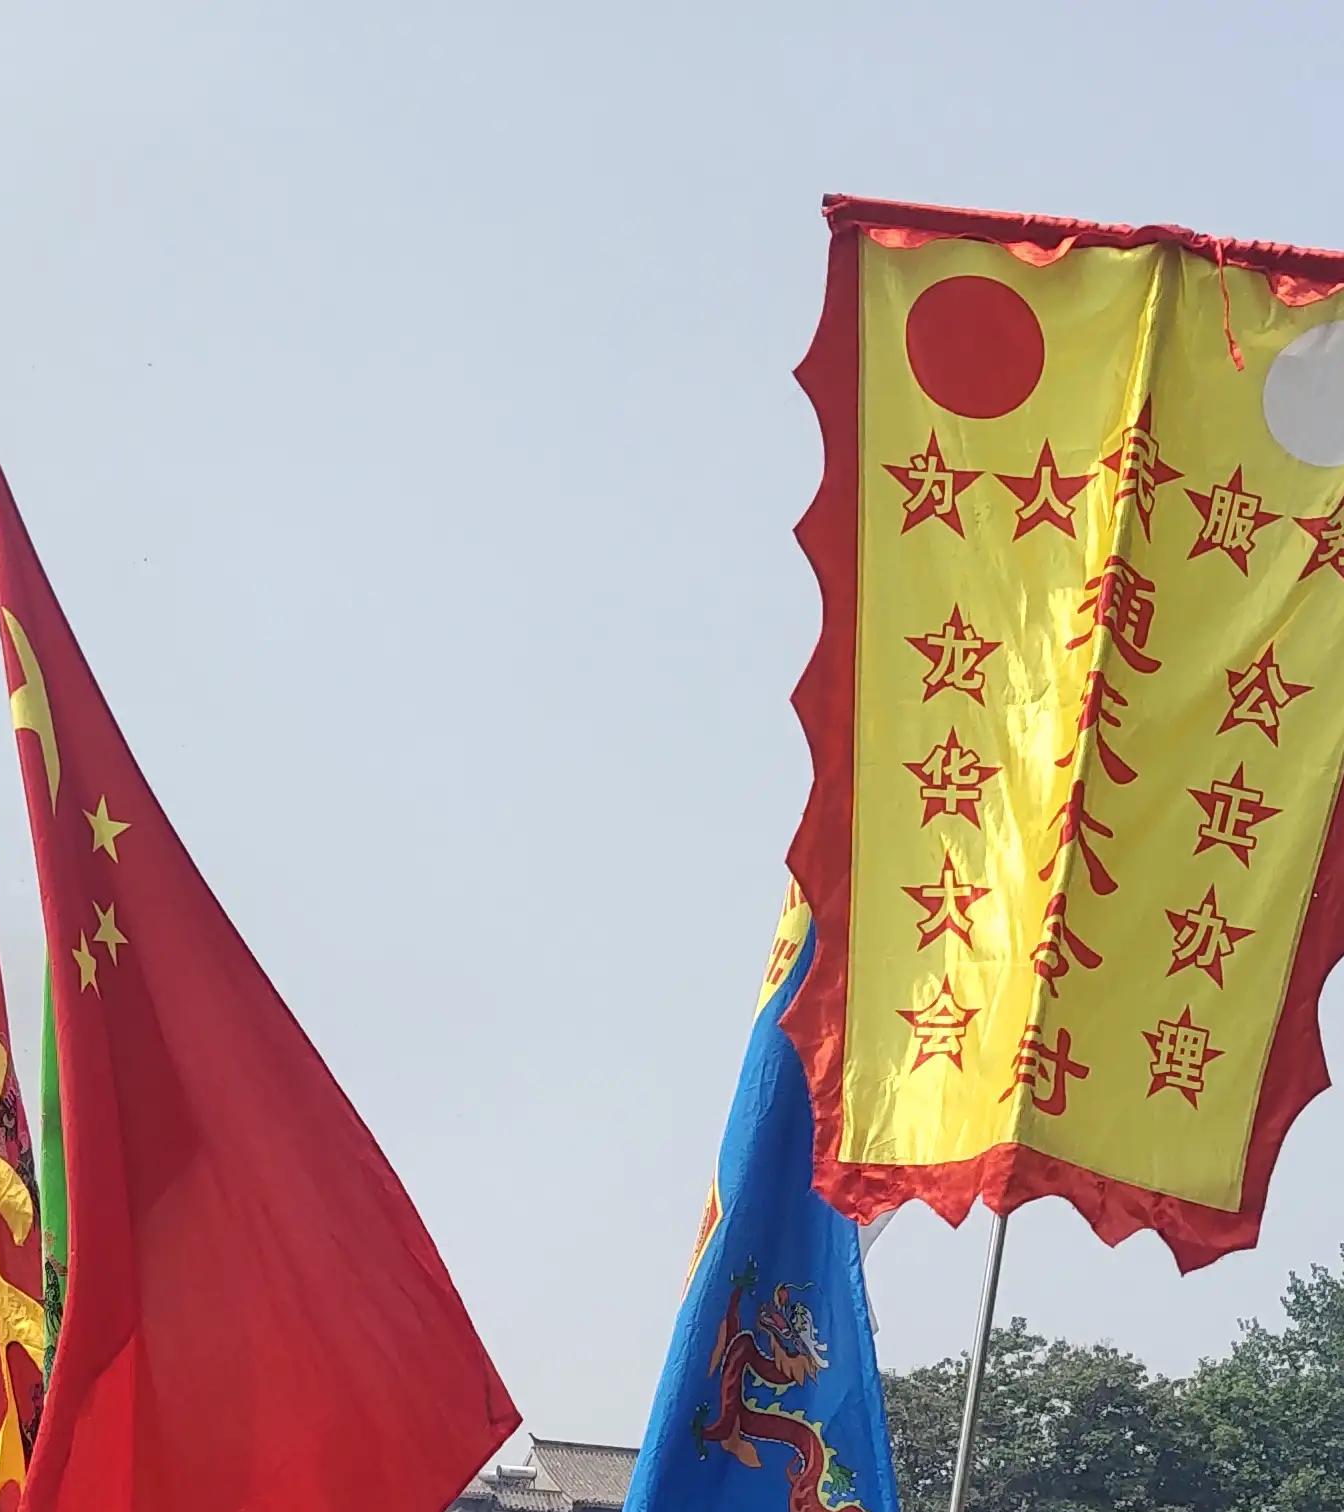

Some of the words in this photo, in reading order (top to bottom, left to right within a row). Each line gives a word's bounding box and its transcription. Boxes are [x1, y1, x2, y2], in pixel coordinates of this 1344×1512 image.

[912, 622, 986, 1057] 龙华大会
[1149, 658, 1296, 1094] 公正办理
